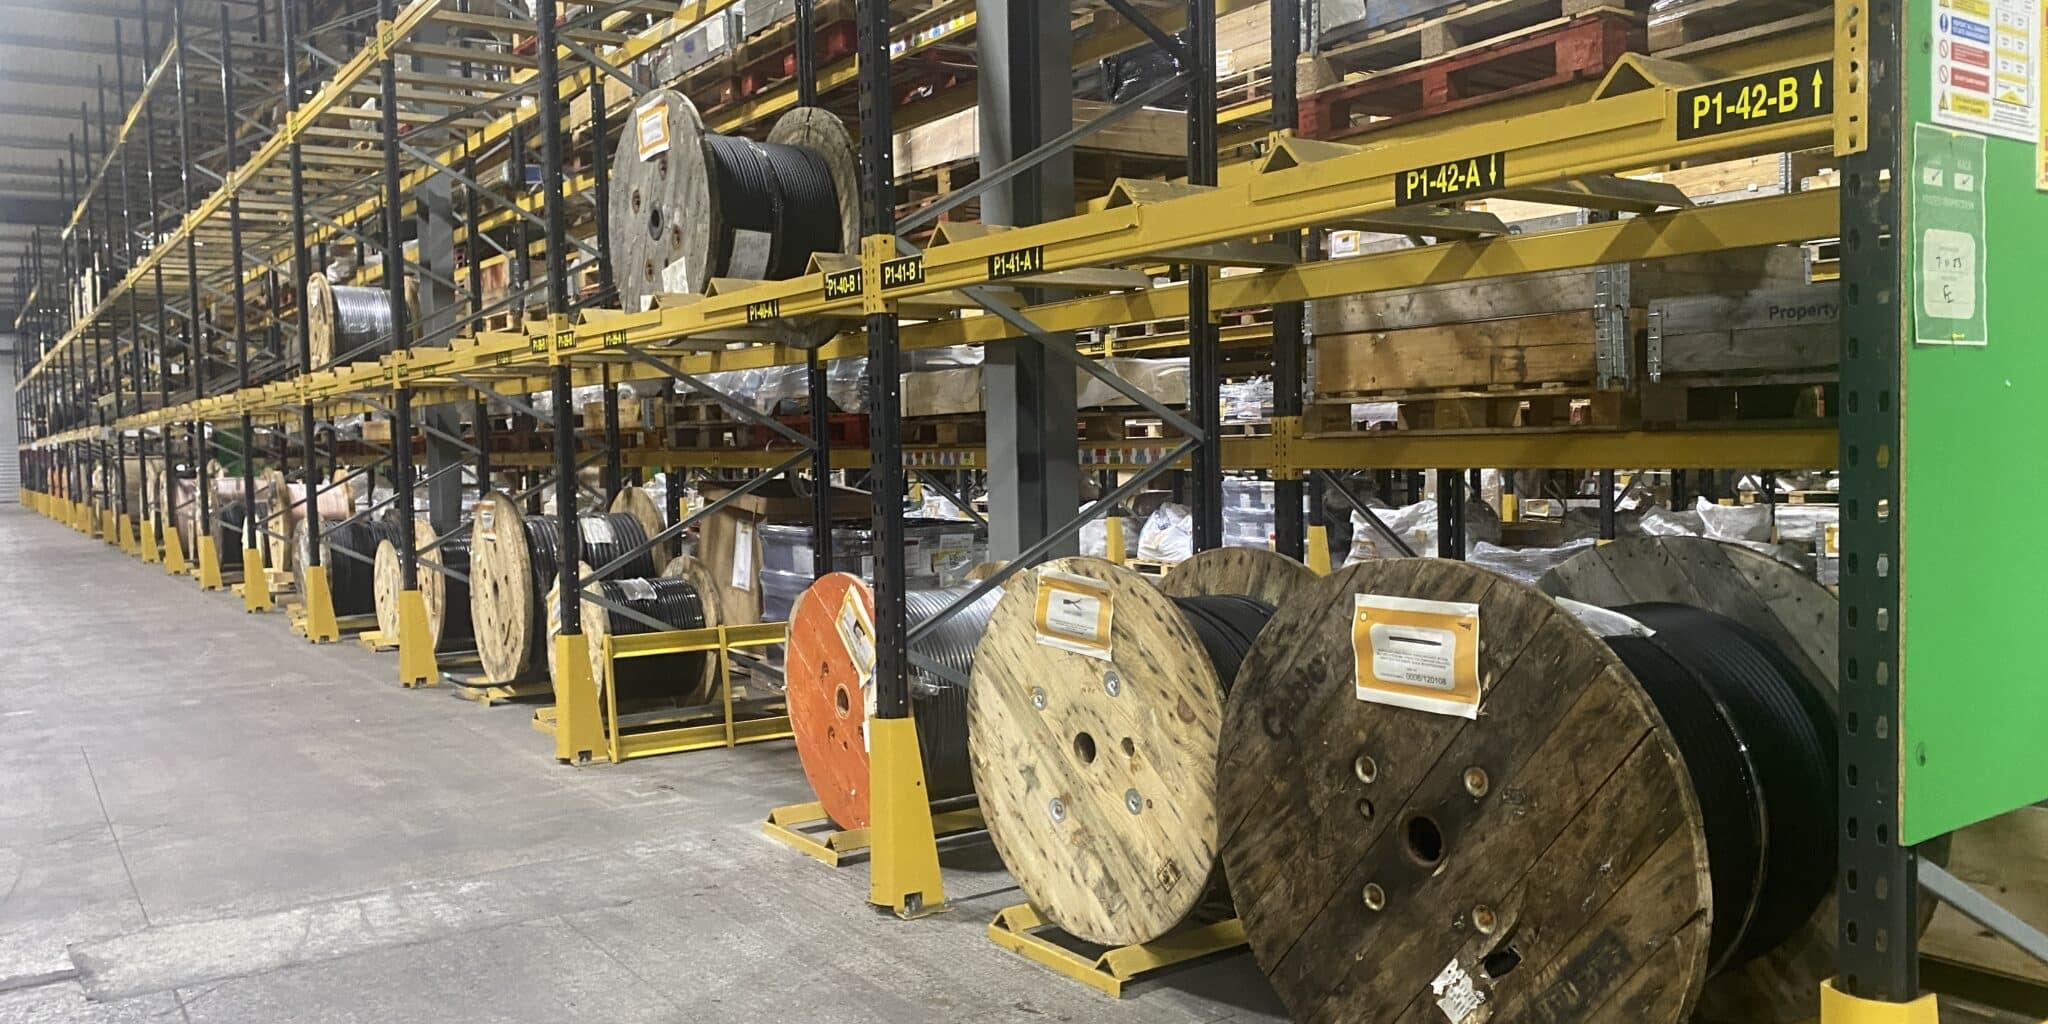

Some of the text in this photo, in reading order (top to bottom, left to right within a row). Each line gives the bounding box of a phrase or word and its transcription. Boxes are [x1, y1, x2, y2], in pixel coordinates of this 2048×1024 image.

[1693, 76, 1798, 129] P1-42-B
[1406, 159, 1481, 200] P1-42-A
[885, 259, 916, 285] P1-41-B
[993, 250, 1032, 277] P1-41-A
[827, 274, 855, 297] P1-40-B
[1768, 303, 1839, 321] Property
